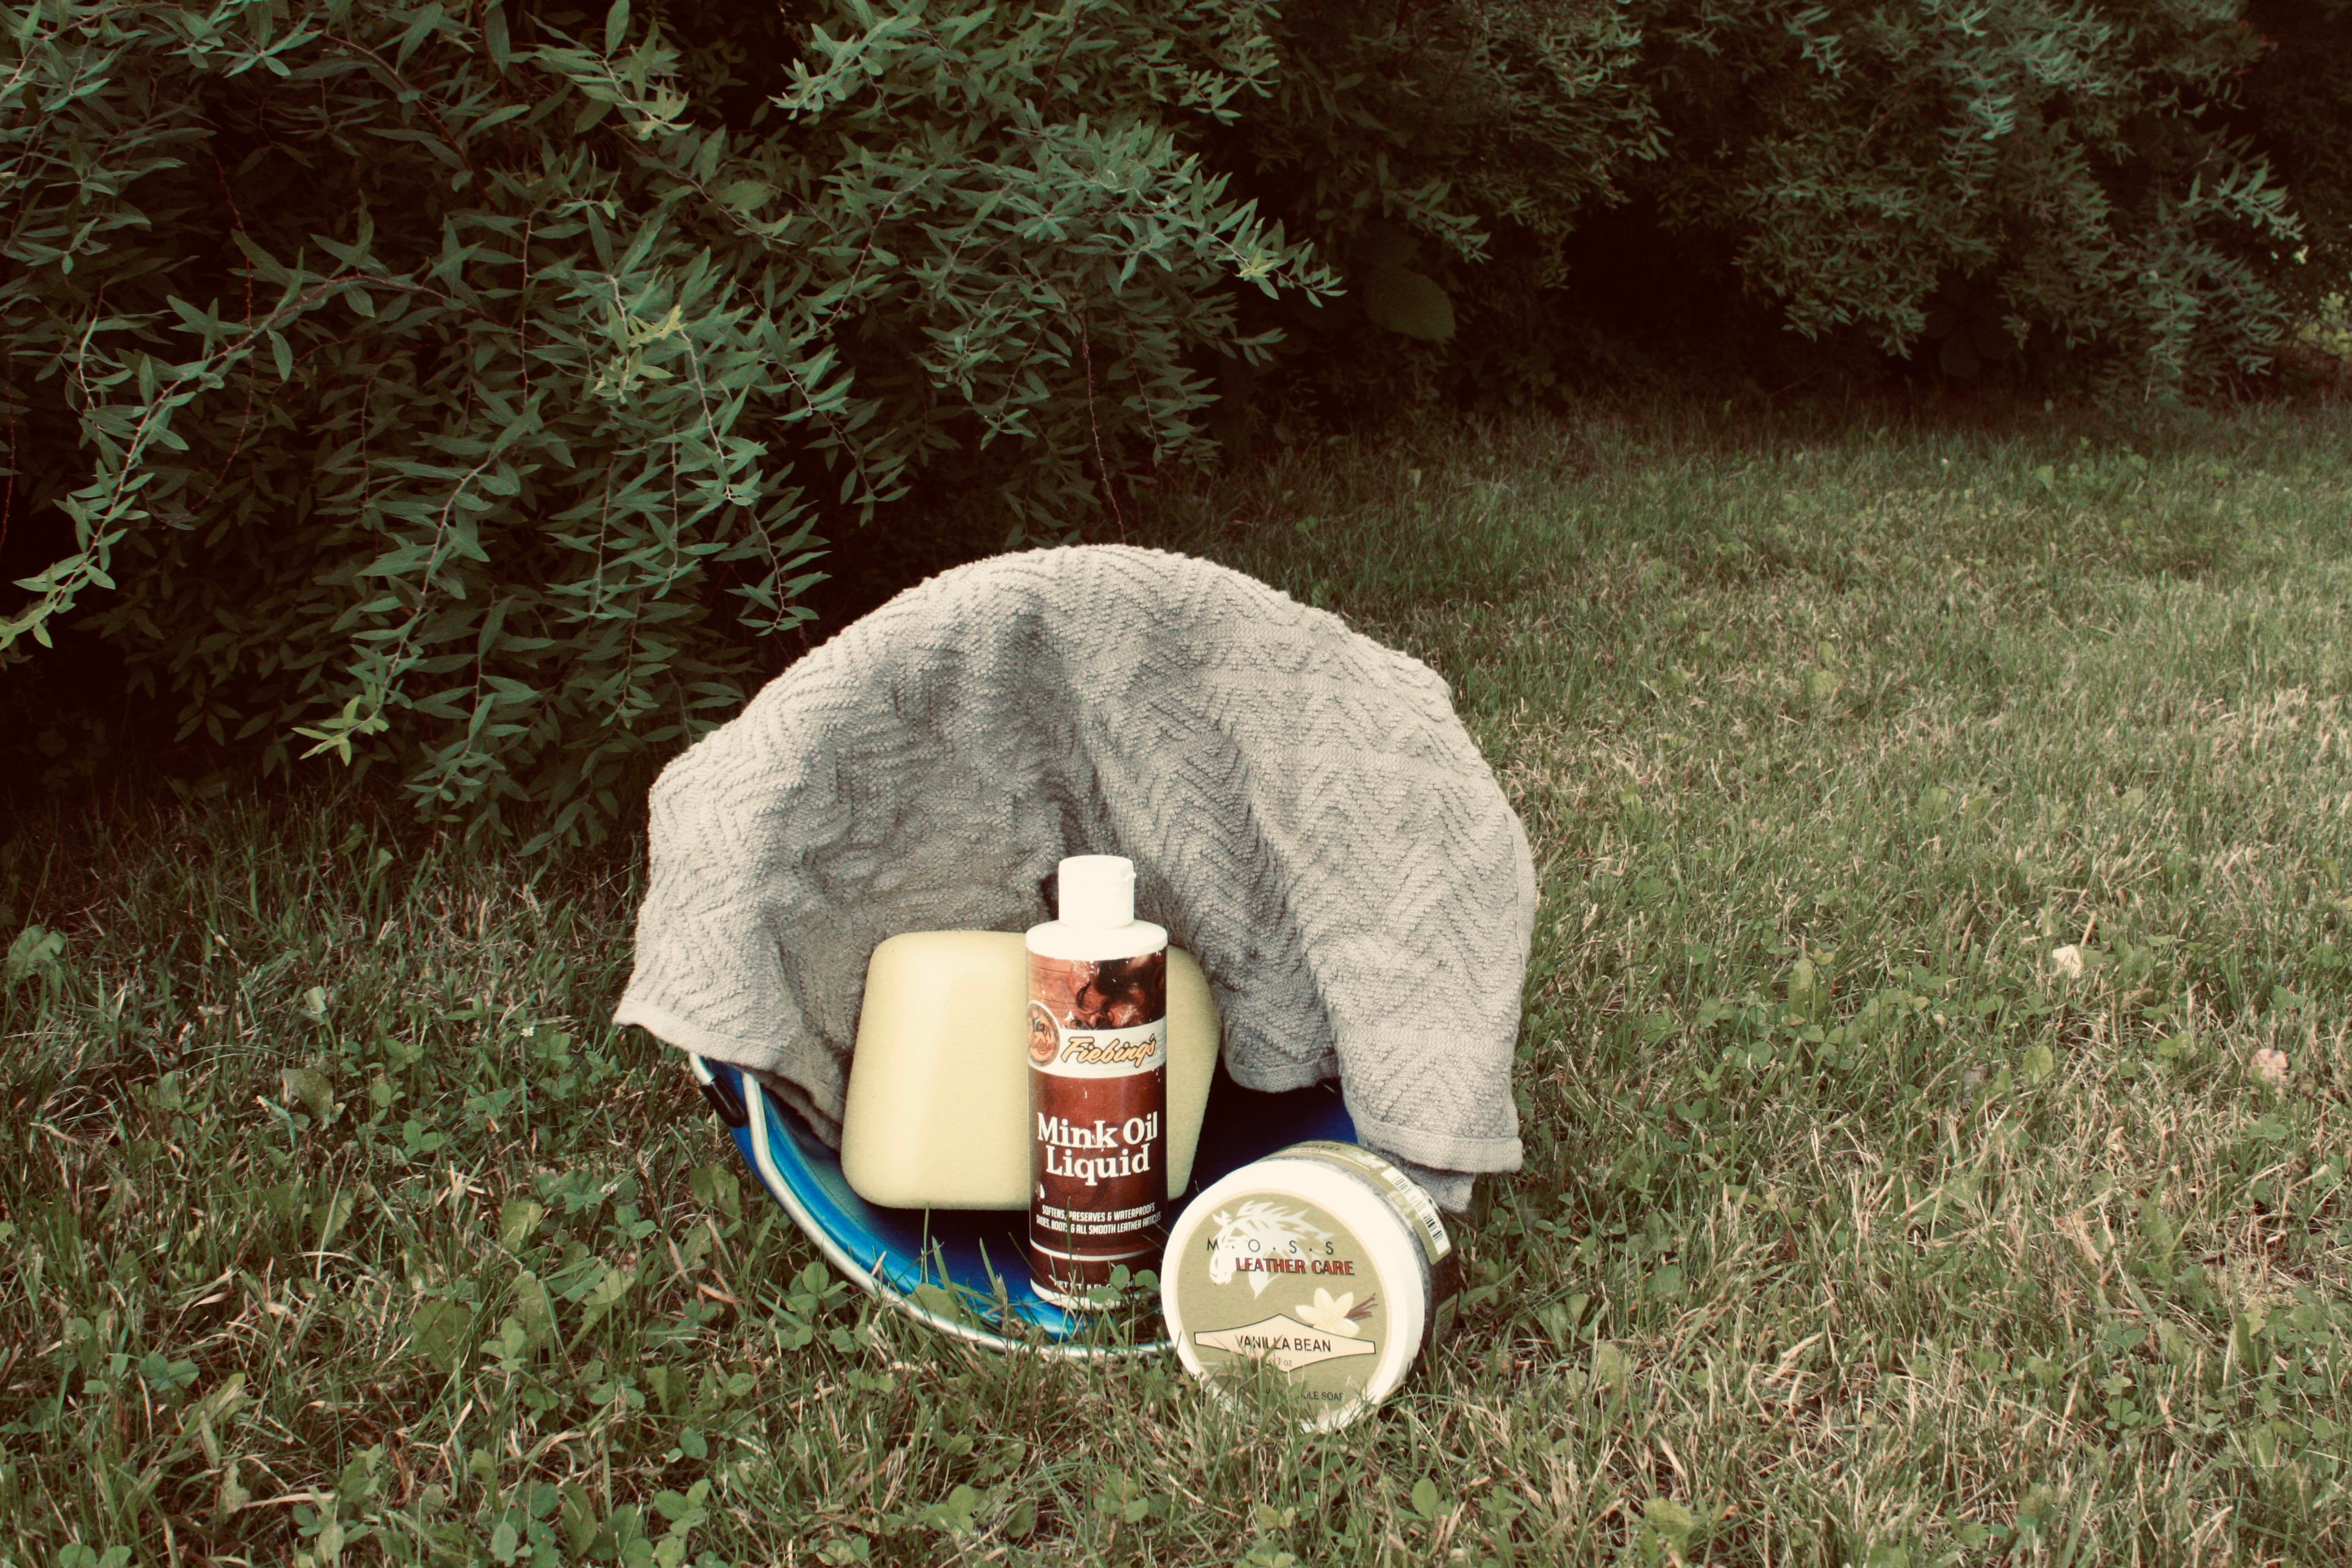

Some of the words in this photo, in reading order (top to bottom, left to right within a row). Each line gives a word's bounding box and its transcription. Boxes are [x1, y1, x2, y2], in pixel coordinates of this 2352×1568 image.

[1060, 1033, 1157, 1069] Fiebing's
[1037, 1111, 1119, 1149] Mink
[1122, 1110, 1158, 1145] Oil
[1045, 1142, 1150, 1186] Liquid
[1042, 1204, 1067, 1222] SOFTENS,
[1068, 1211, 1106, 1222] PRESERVES
[1107, 1211, 1112, 1222] &
[1113, 1202, 1156, 1221] WATERPROOFS
[1070, 1223, 1075, 1233] &
[1076, 1224, 1087, 1234] ALL
[1088, 1223, 1116, 1234] SMOOTH
[1117, 1219, 1142, 1233] LEATHER
[1142, 1211, 1162, 1227] ARTICLES
[1235, 1257, 1306, 1274] LEATHER
[1311, 1259, 1355, 1276] CARE
[1294, 1337, 1331, 1353] BEAN
